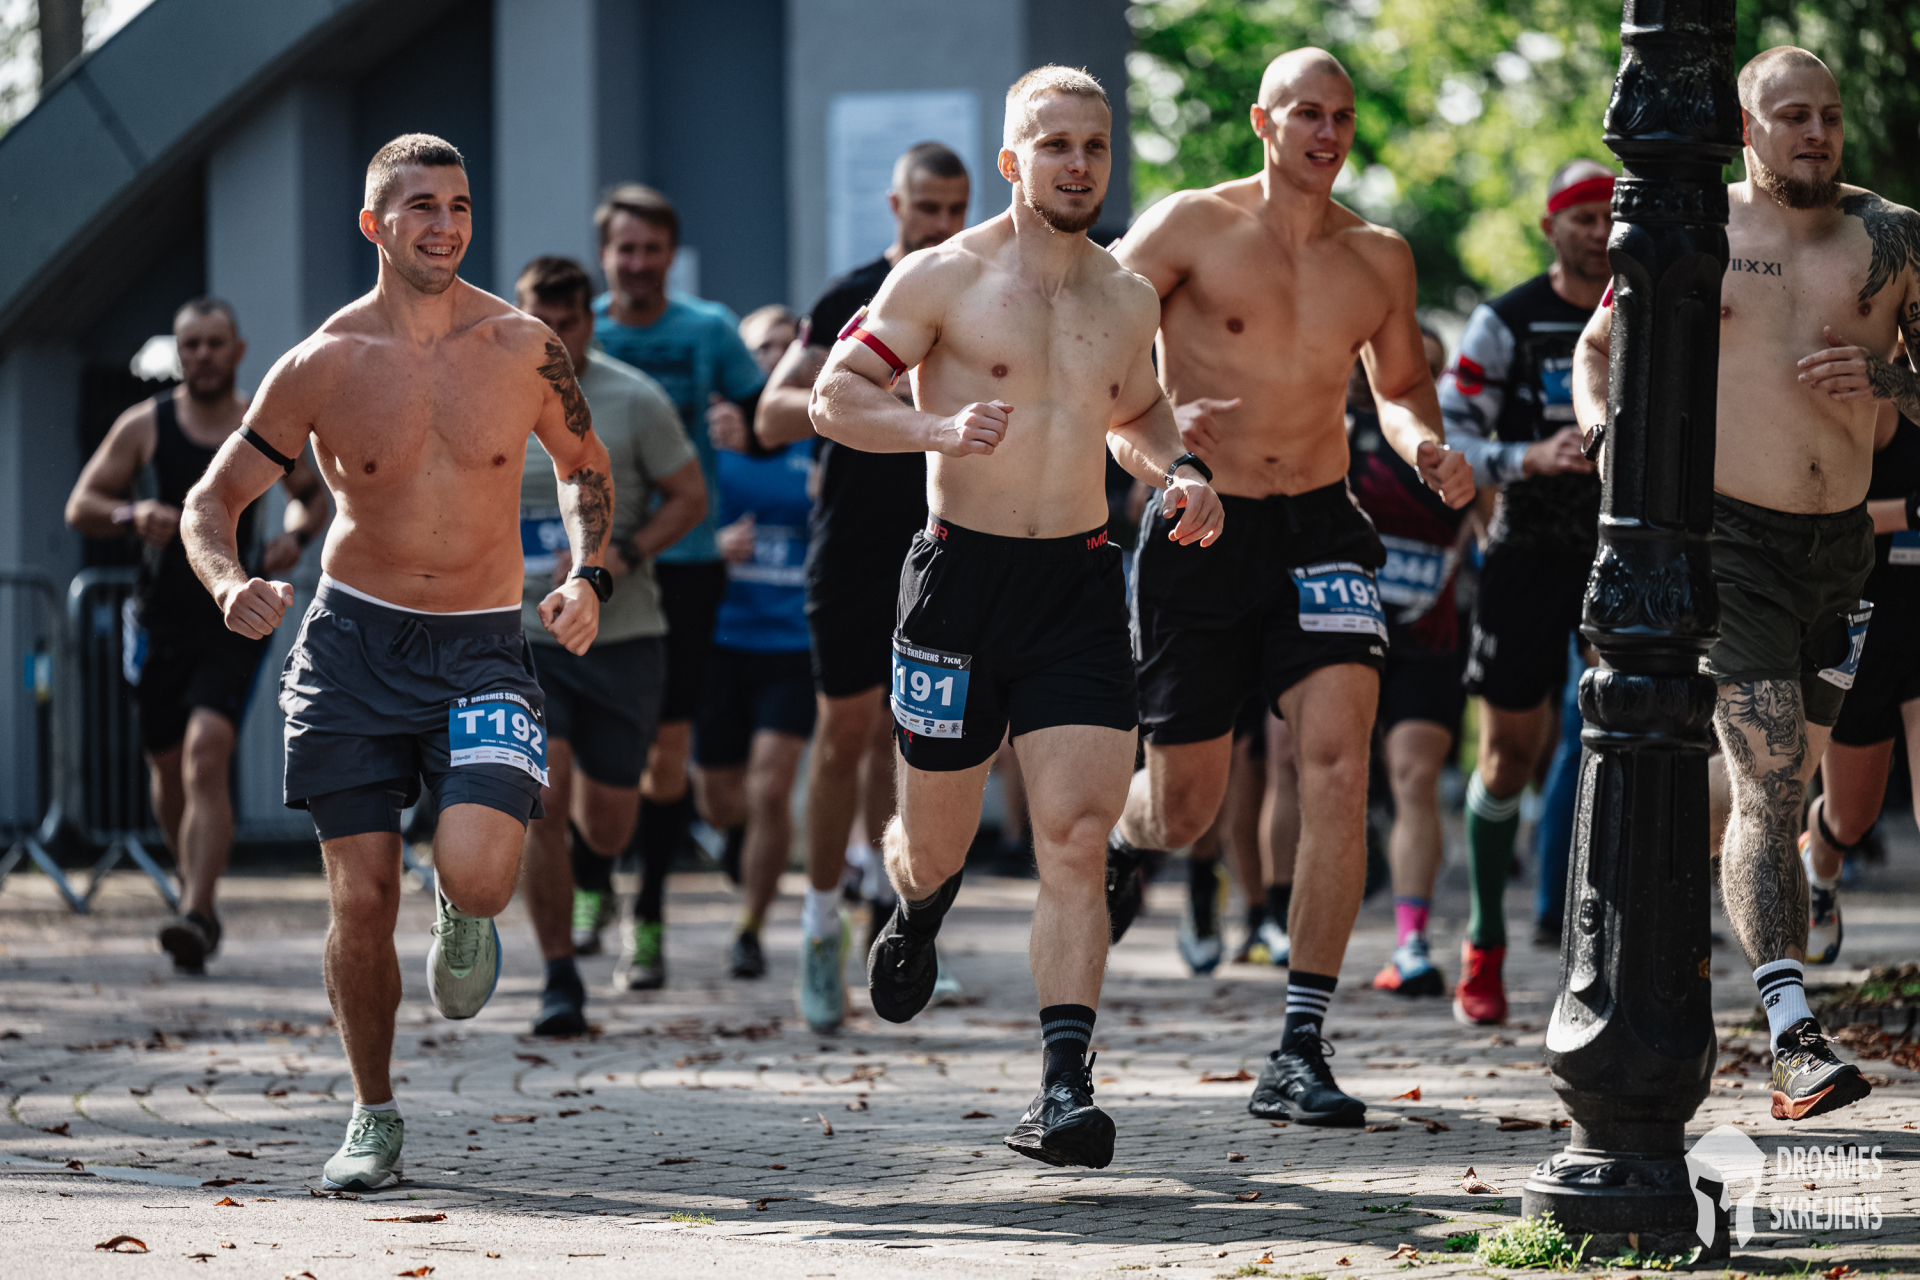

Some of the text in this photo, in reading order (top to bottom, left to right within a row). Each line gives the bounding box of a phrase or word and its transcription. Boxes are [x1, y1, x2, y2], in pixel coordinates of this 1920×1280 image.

[1302, 577, 1381, 612] T193
[893, 660, 953, 706] 191
[457, 709, 543, 756] T192
